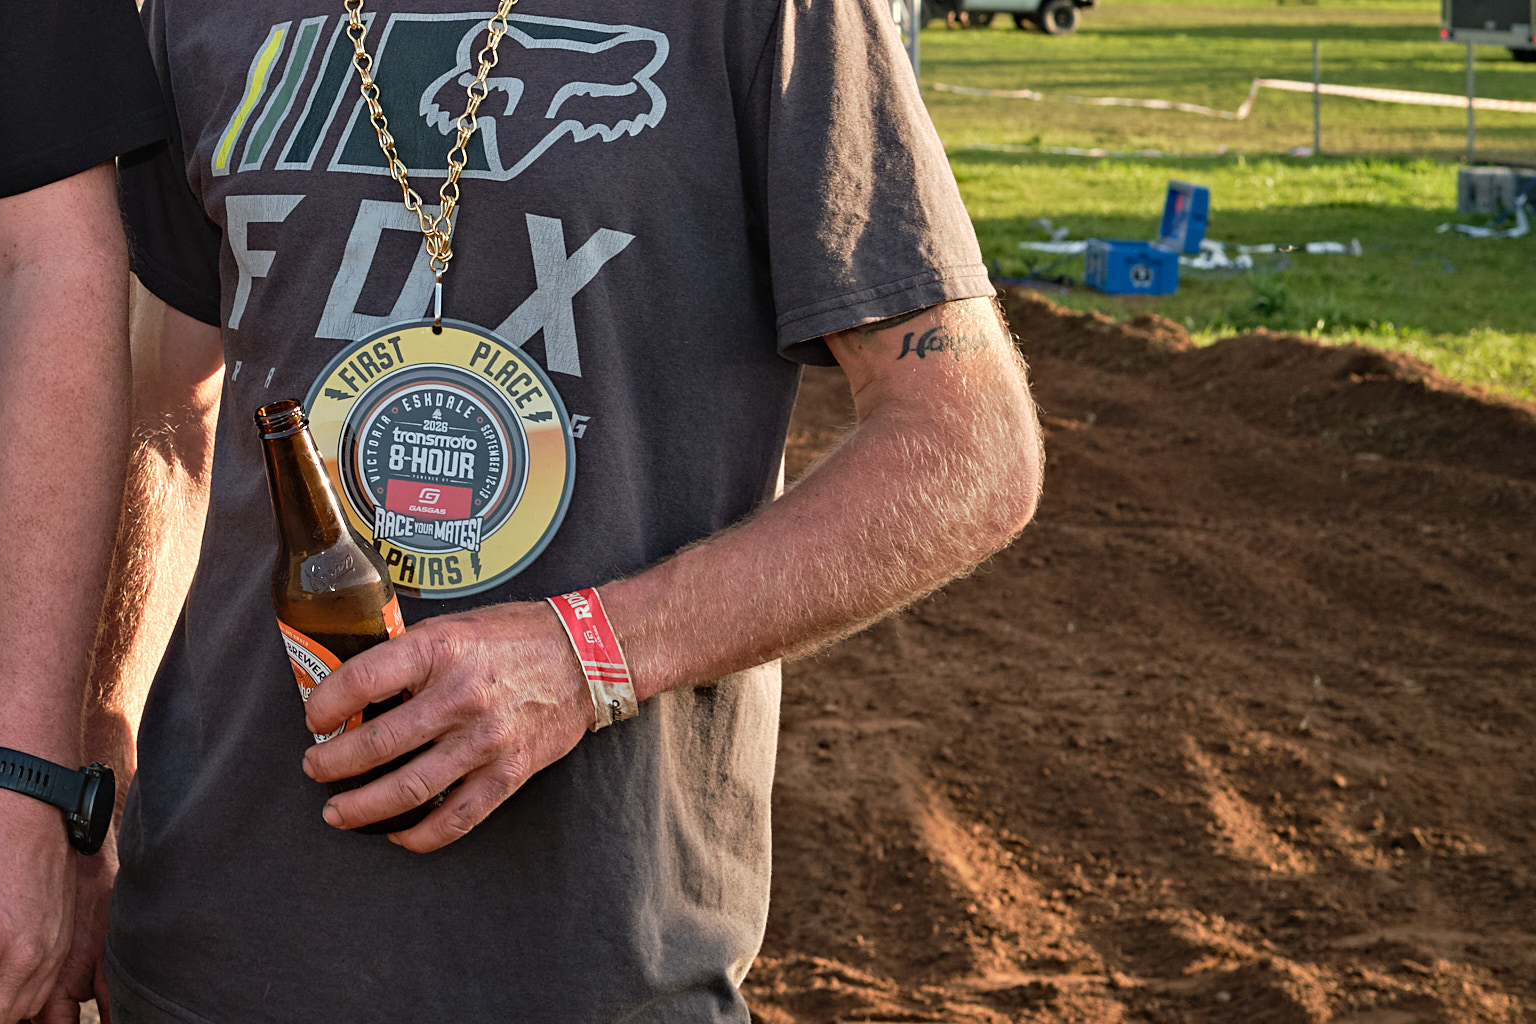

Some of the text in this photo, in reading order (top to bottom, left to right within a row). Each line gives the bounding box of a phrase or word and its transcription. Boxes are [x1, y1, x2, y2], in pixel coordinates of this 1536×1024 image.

[225, 193, 636, 378] FOX
[337, 335, 543, 409] FIRST PLACE
[392, 426, 478, 451] transmoto
[423, 419, 449, 433] 2026
[366, 415, 392, 483] VICTORIA
[388, 444, 476, 480] 8-HOUR
[479, 424, 500, 499] SEPTEMBER 12-13
[374, 507, 483, 552] RACE YOUR MATES!
[409, 505, 446, 515] GASGAS
[386, 547, 462, 586] PAIRS
